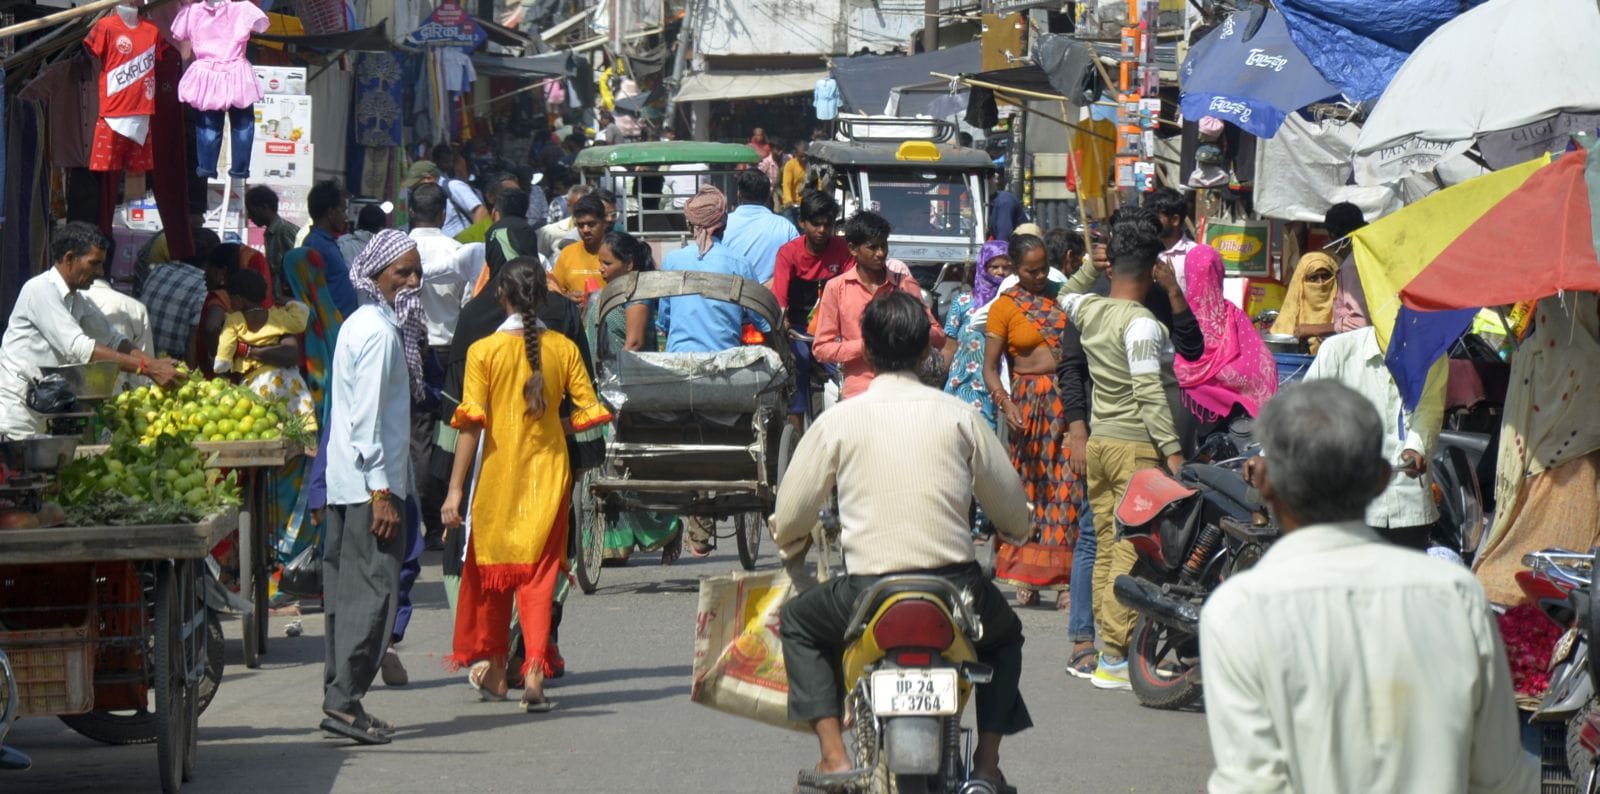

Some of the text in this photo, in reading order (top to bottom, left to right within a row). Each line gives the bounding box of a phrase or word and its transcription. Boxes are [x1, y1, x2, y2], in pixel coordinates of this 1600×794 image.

[896, 680, 934, 694] UP 24
[908, 695, 941, 711] 3764
